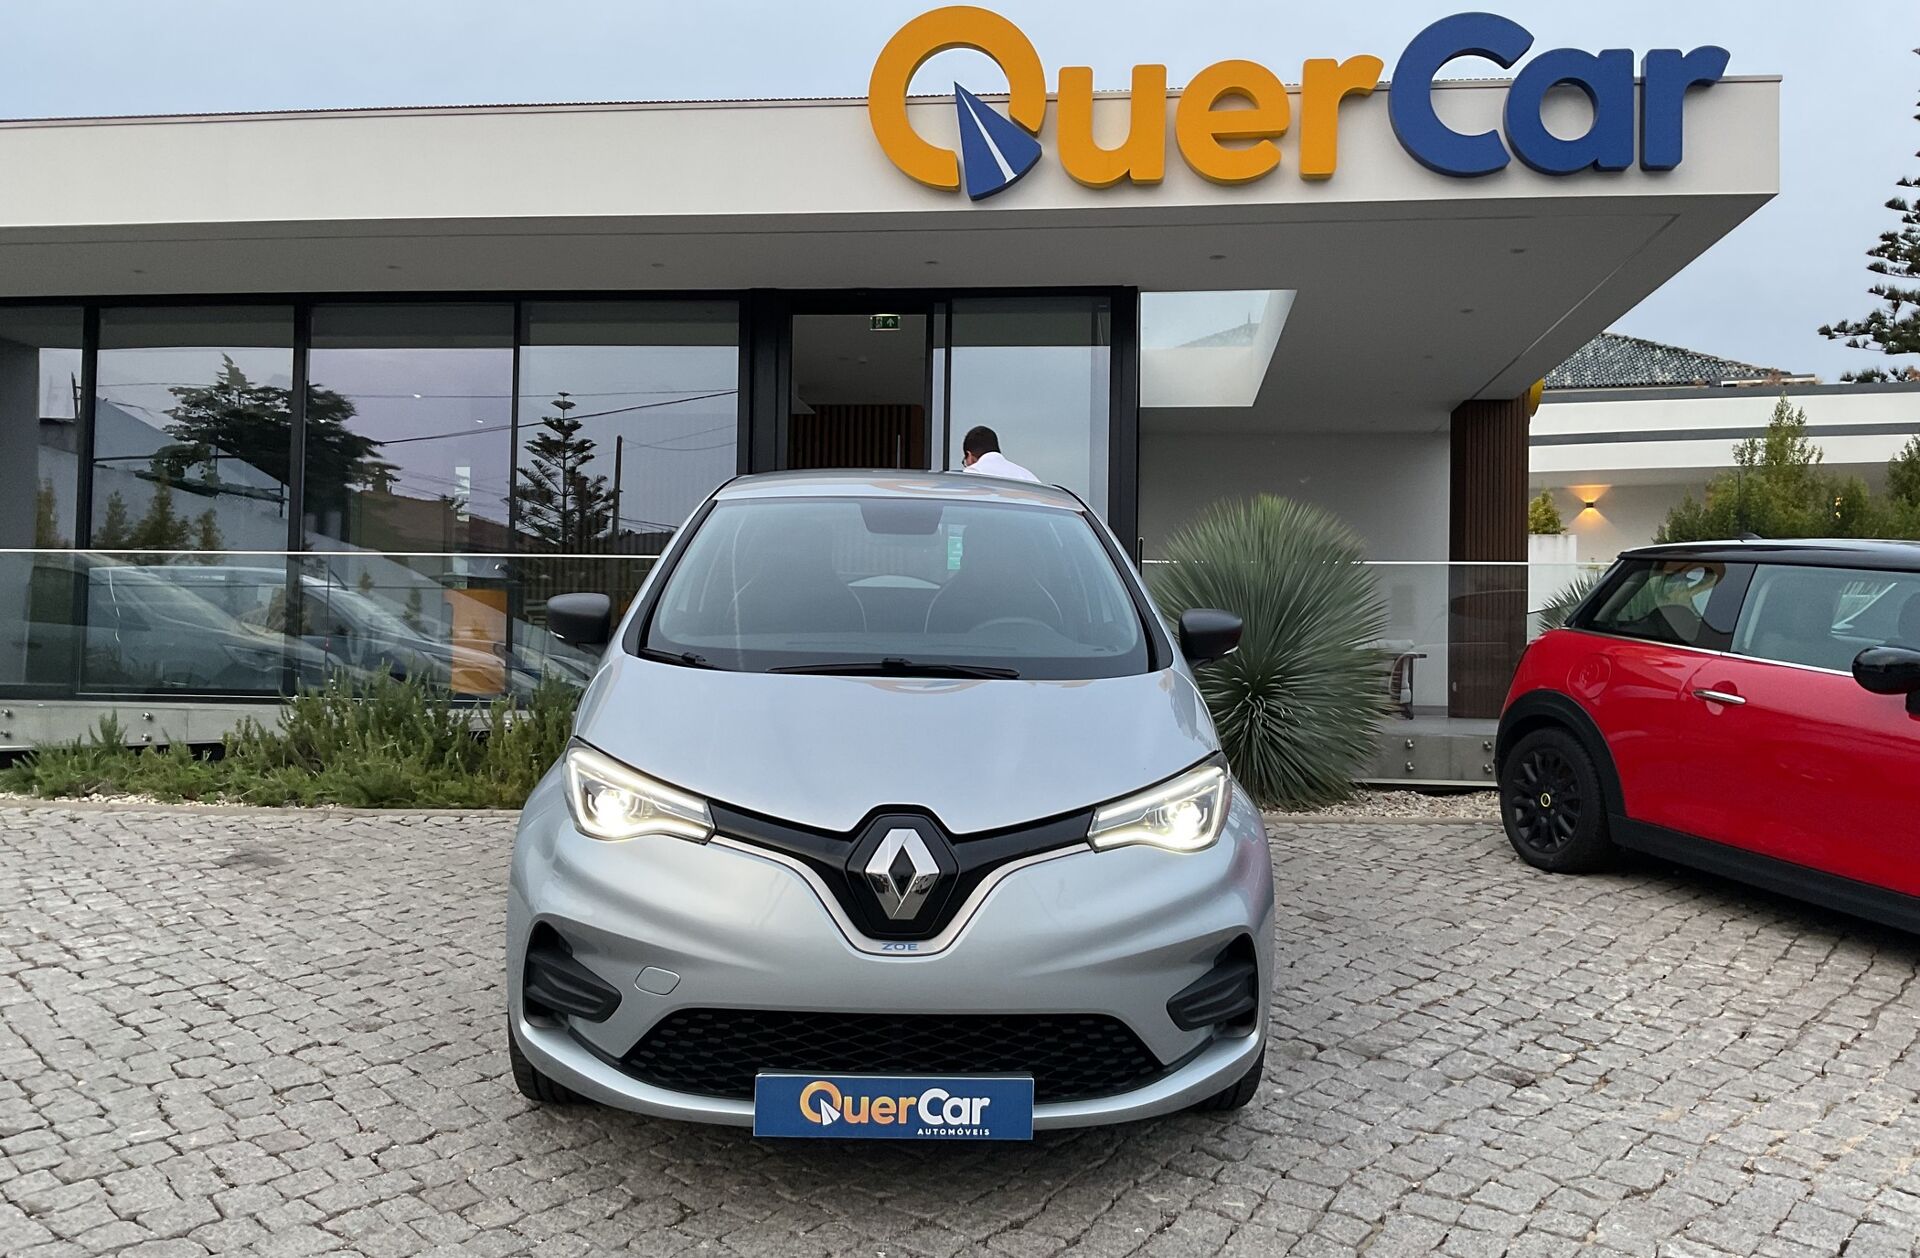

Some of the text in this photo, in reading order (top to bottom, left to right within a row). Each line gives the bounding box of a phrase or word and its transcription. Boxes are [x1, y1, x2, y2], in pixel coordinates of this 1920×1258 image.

[868, 5, 1730, 201] QuerCar
[881, 942, 919, 951] ZOE
[799, 1080, 990, 1126] QuerCar
[917, 1127, 990, 1136] AUTOMÓVEIS
